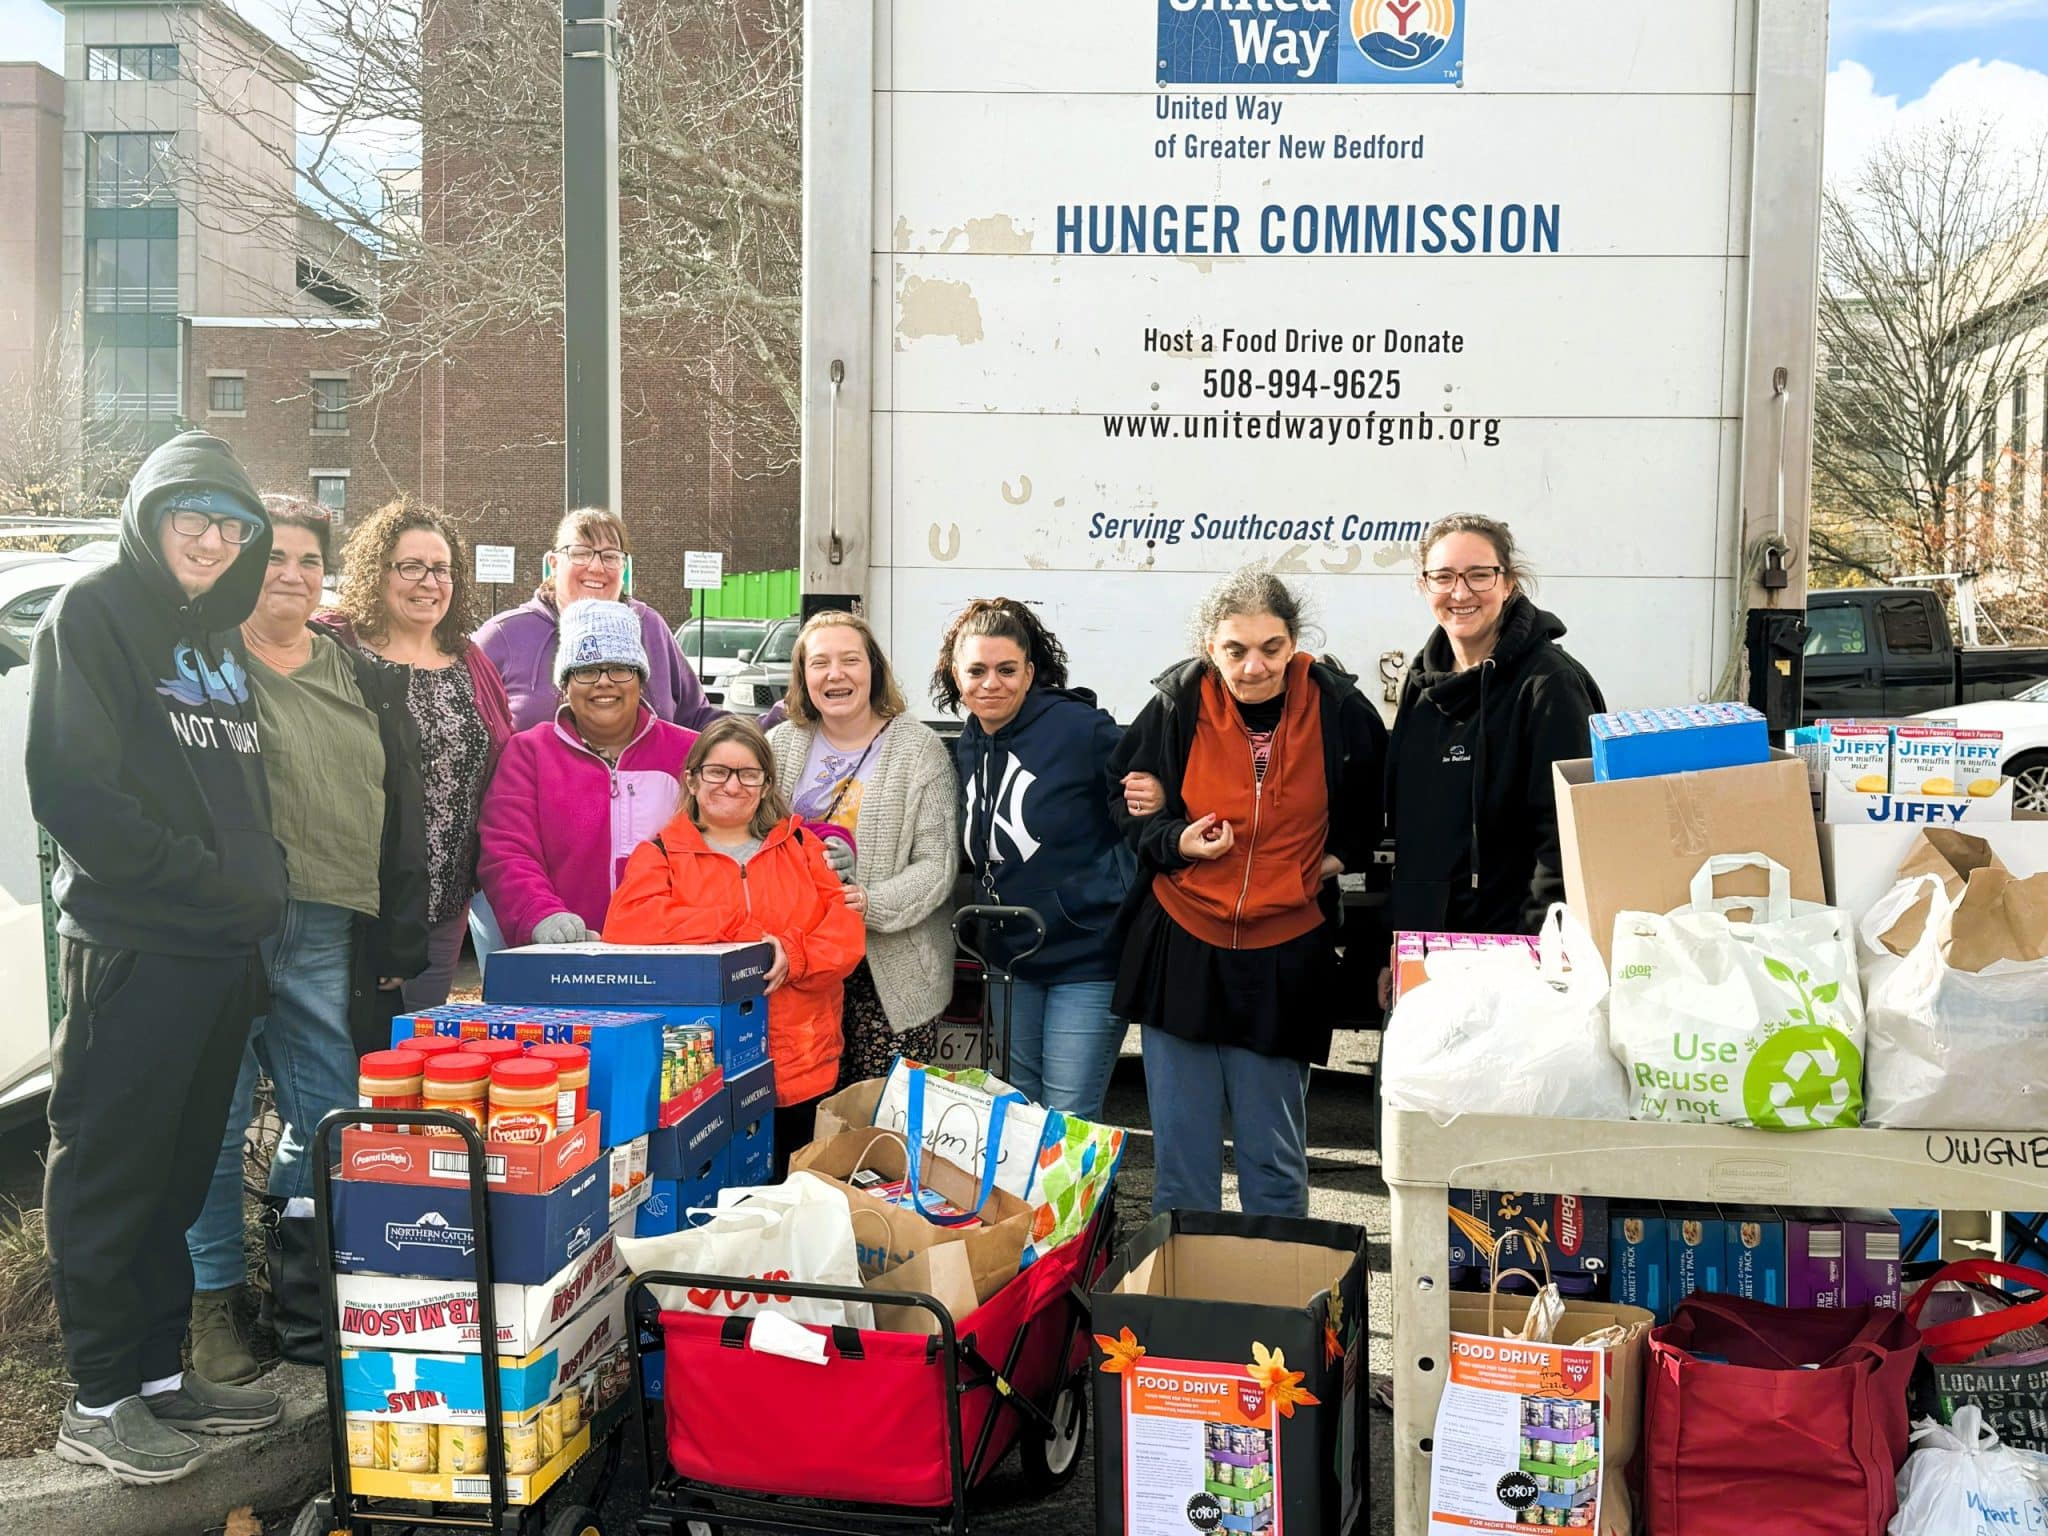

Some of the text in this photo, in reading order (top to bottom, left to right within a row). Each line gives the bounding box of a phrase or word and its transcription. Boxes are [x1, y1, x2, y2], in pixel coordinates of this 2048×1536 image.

[1229, 18, 1330, 78] Way
[1156, 95, 1284, 125] United Way
[1154, 134, 1425, 161] of Greater New Bedford
[1056, 204, 1561, 255] HUNGER COMMISSION
[1143, 328, 1465, 354] Host a Food Drive or Donate
[1202, 368, 1402, 401] 508-994-9625
[1102, 411, 1502, 446] www.unitedwayofgnb.org
[1088, 511, 1183, 545] Serving
[1190, 512, 1334, 543] Southcoast
[169, 711, 261, 754] NOT TODAY
[1832, 739, 1887, 755] JIFFY
[1898, 740, 1954, 757] JIFFY
[1857, 755, 1884, 763] muffin
[1917, 765, 1934, 773] mix
[1922, 757, 1950, 765] muffin
[1969, 758, 1997, 767] muffin
[1963, 766, 1981, 774] mix
[551, 974, 652, 985] HAMMERMILL
[731, 965, 765, 982] HAMMERMILL
[1673, 1032, 1738, 1063] Use
[1634, 1062, 1729, 1093] Reuse
[740, 1084, 771, 1109] HAMMERMILL
[1641, 1093, 1721, 1119] try not
[493, 1125, 543, 1144] Creamy
[688, 1114, 724, 1151] HAMMERMILL
[356, 1150, 407, 1166] Peanut Delight
[1561, 1194, 1578, 1247] Barilla
[390, 1226, 440, 1238] NORTHERN
[441, 1230, 472, 1241] CATCH
[1686, 1248, 1694, 1270] PACK
[1744, 1250, 1753, 1272] PACK
[1627, 1246, 1636, 1303] VARIETY PACK
[496, 1328, 513, 1340] WH
[1452, 1341, 1551, 1367] FOOD DRIVE
[1567, 1365, 1590, 1375] NOV
[1571, 1374, 1583, 1383] 19
[1136, 1375, 1229, 1396] FOOD DRIVE
[1939, 1373, 2022, 1393] LOCALLY
[1243, 1394, 1262, 1404] NOV
[1247, 1403, 1257, 1412] 19
[1469, 1519, 1484, 1527] FOR
[1484, 1521, 1505, 1530] MORE
